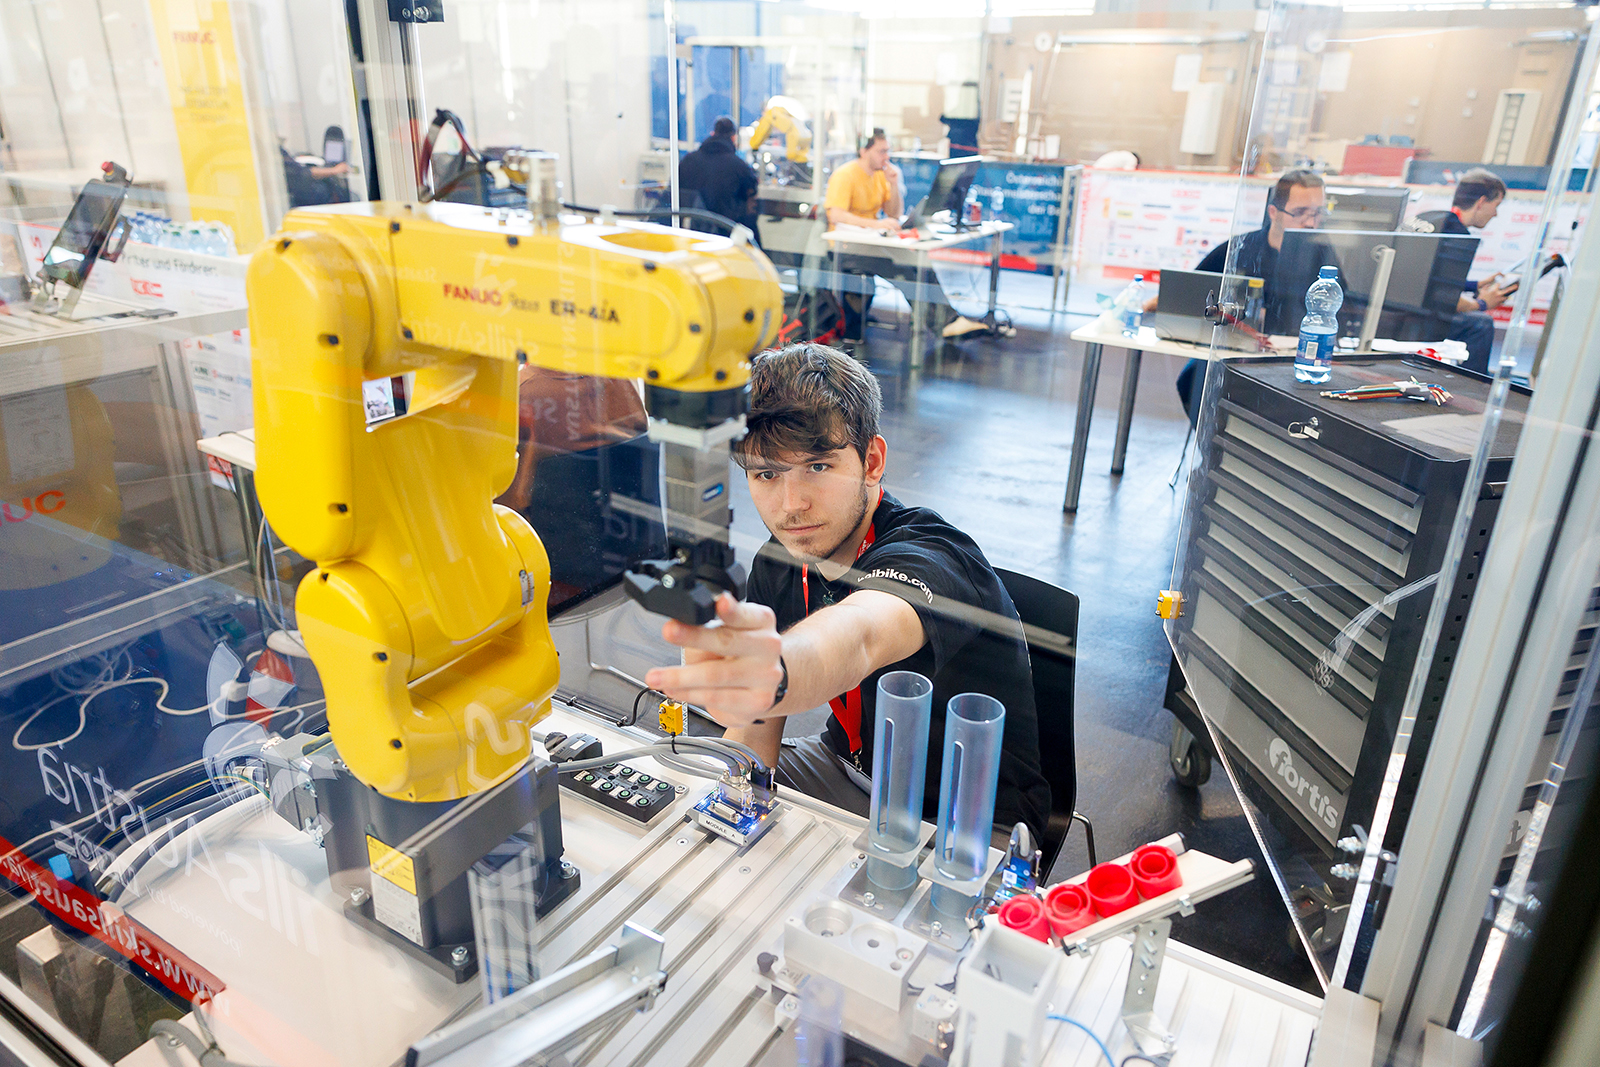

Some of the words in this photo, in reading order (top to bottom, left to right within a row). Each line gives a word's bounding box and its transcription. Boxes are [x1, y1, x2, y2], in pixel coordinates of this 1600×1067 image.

[443, 283, 502, 307] FANUC
[1269, 737, 1340, 830] fortis
[706, 820, 727, 833] MODULE
